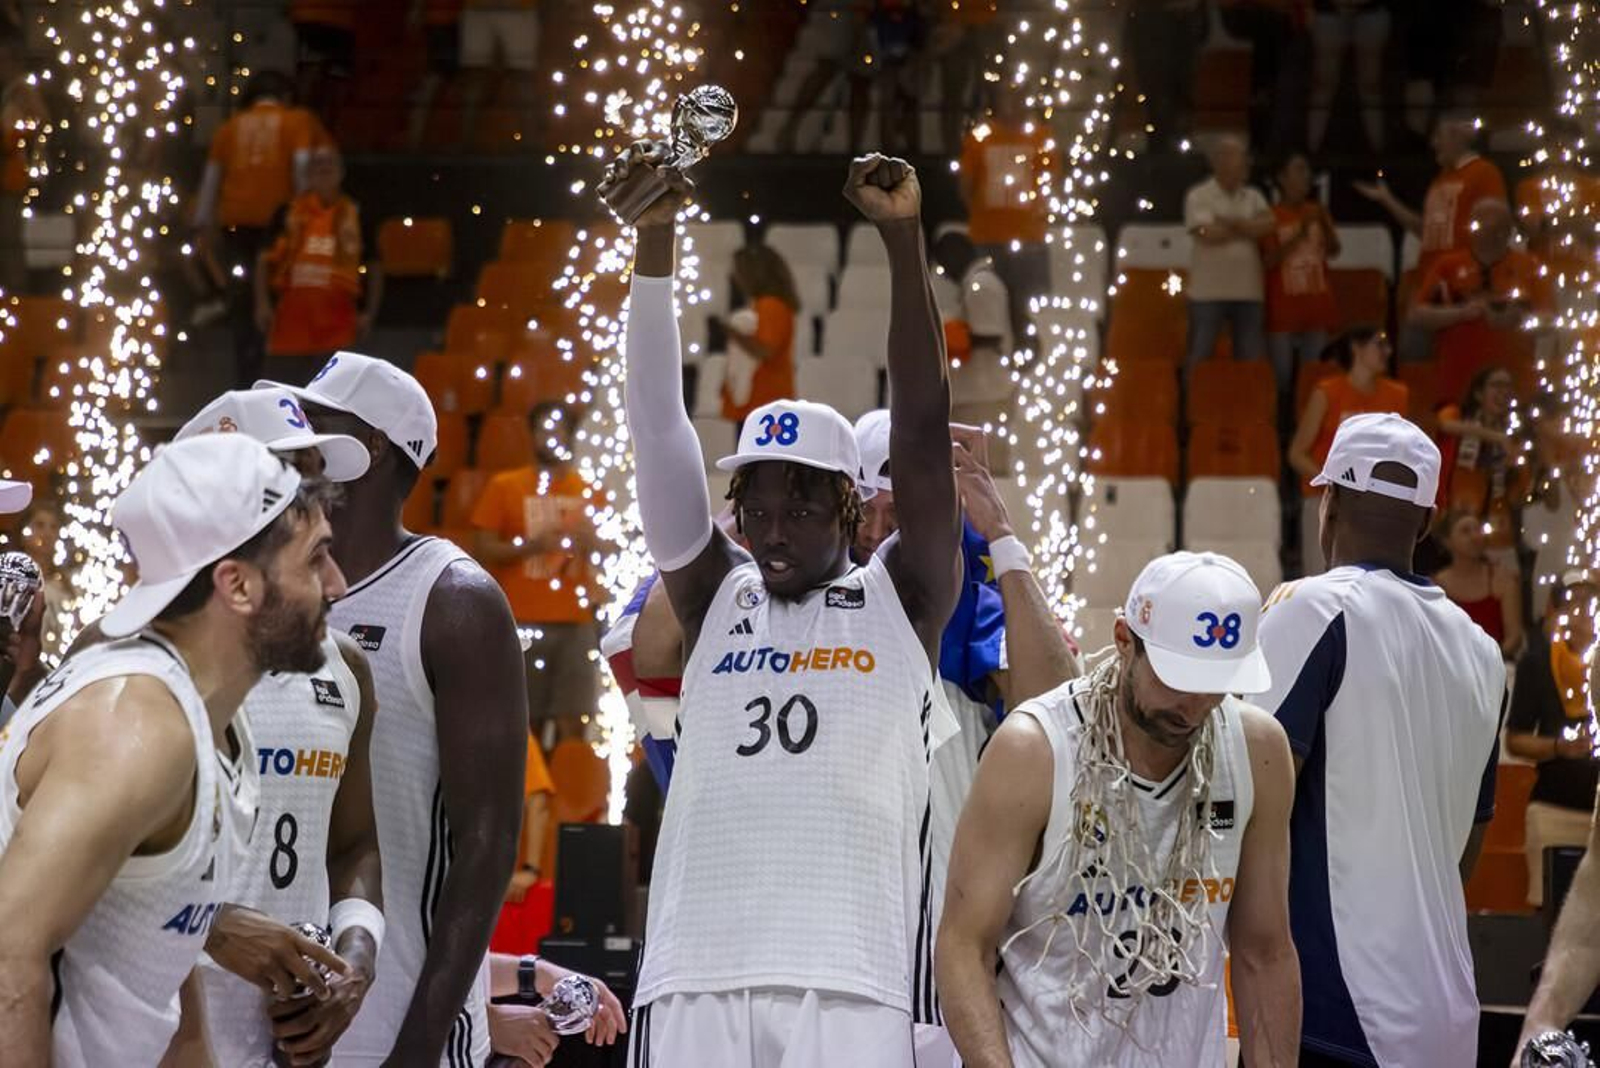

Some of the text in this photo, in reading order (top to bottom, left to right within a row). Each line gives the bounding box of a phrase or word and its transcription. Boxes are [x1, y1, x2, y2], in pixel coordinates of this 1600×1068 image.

[755, 412, 800, 446] 38
[1193, 611, 1241, 649] 38
[712, 647, 876, 674] AUTOHERO
[736, 693, 818, 757] 30
[269, 813, 298, 890] 8
